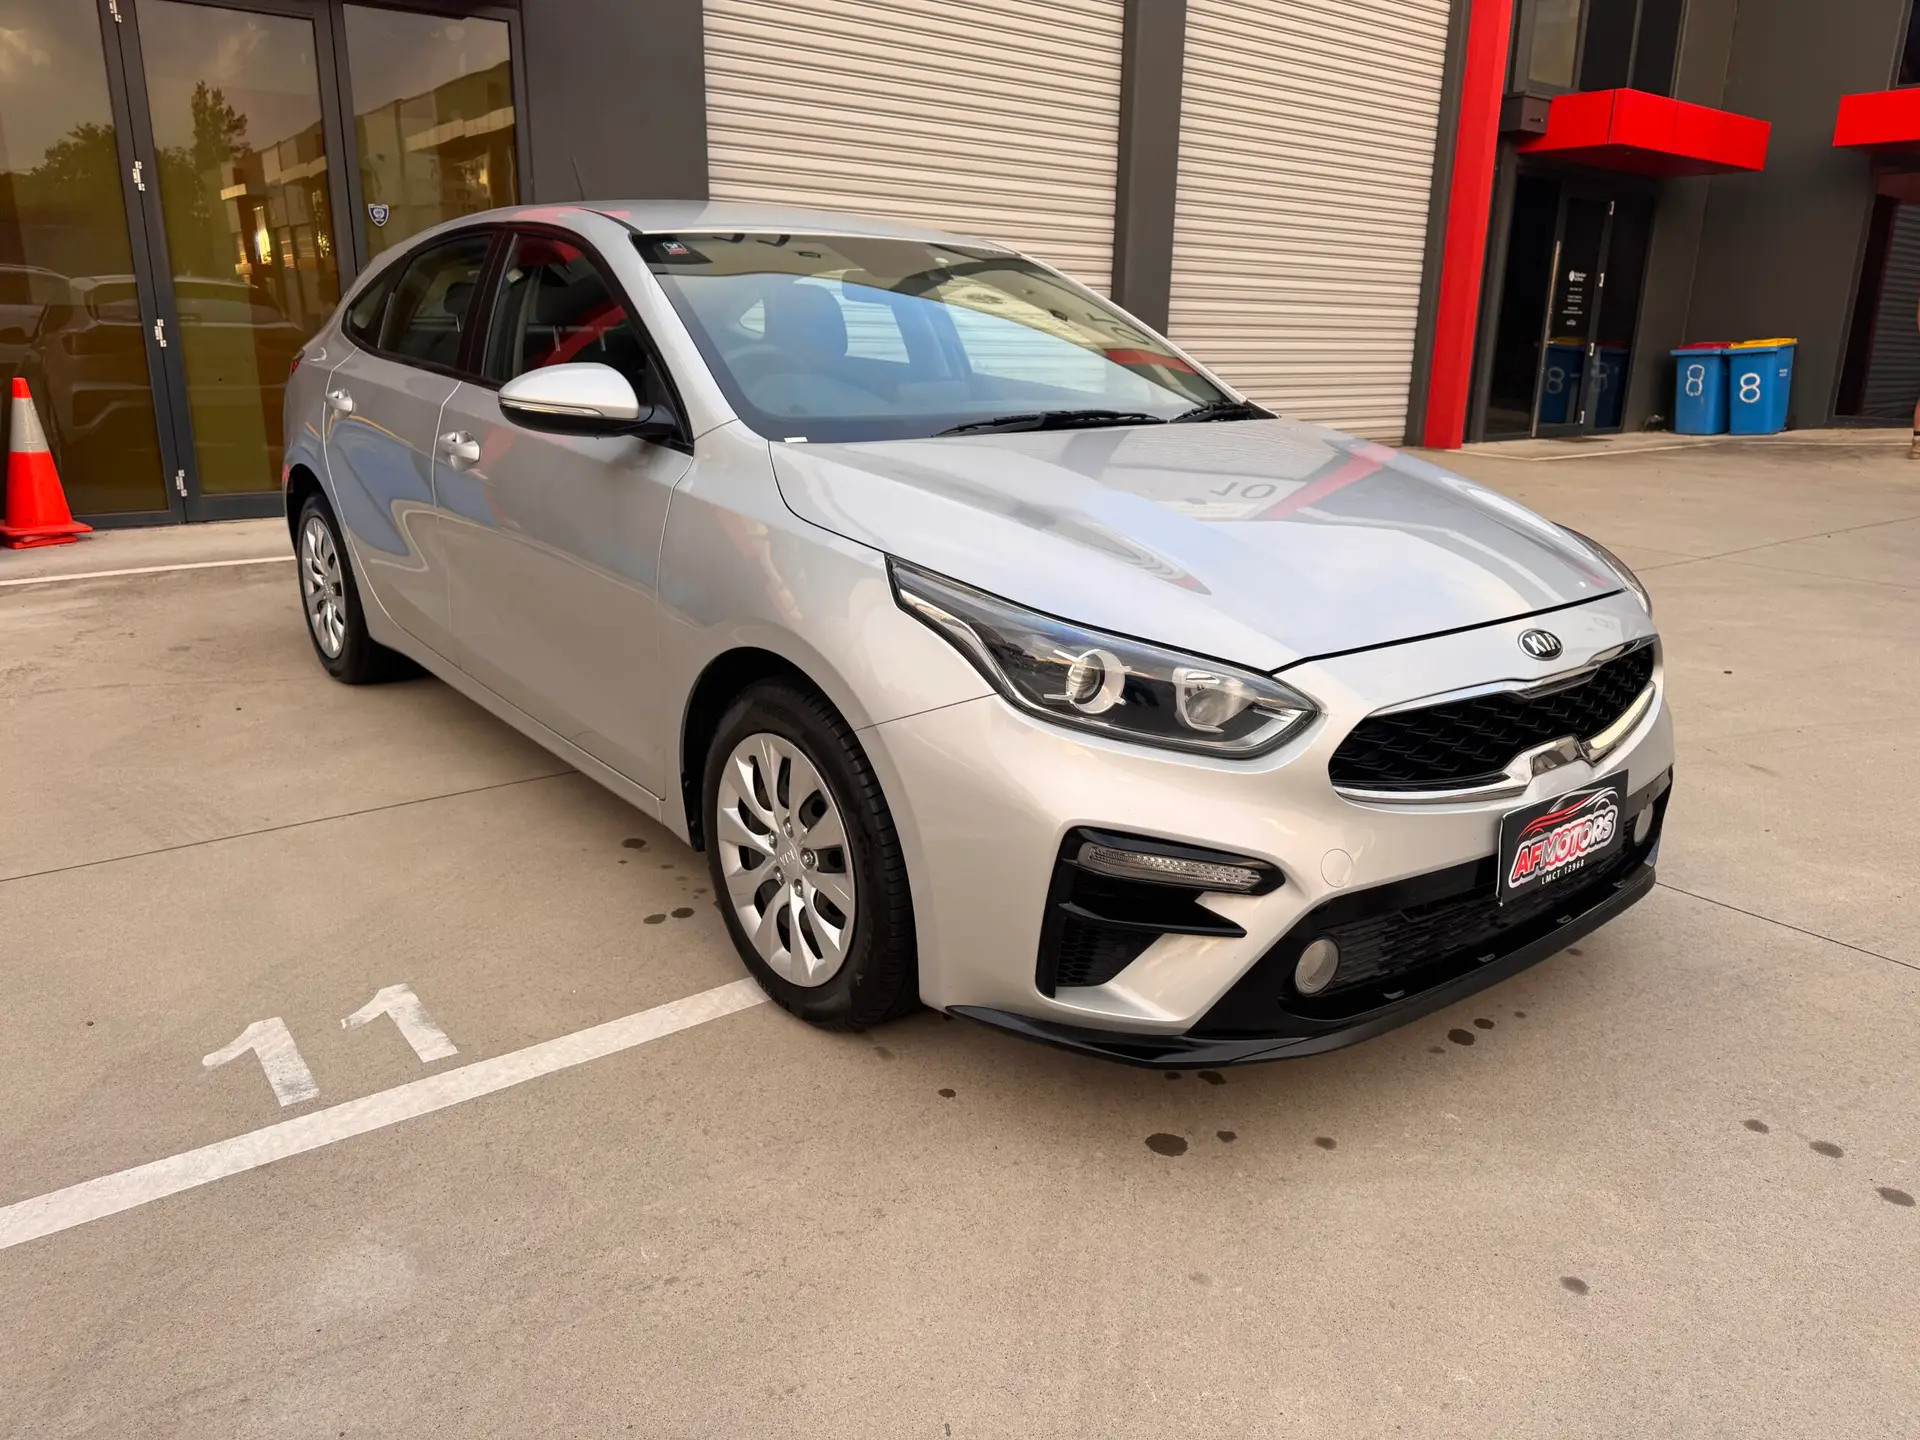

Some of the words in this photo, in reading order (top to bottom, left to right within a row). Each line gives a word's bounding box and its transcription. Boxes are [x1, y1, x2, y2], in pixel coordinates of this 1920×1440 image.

[1686, 364, 1705, 397] 8
[1740, 373, 1761, 403] 8
[1523, 632, 1562, 655] KIA
[1541, 869, 1561, 885] LMCT
[201, 983, 460, 1107] 11
